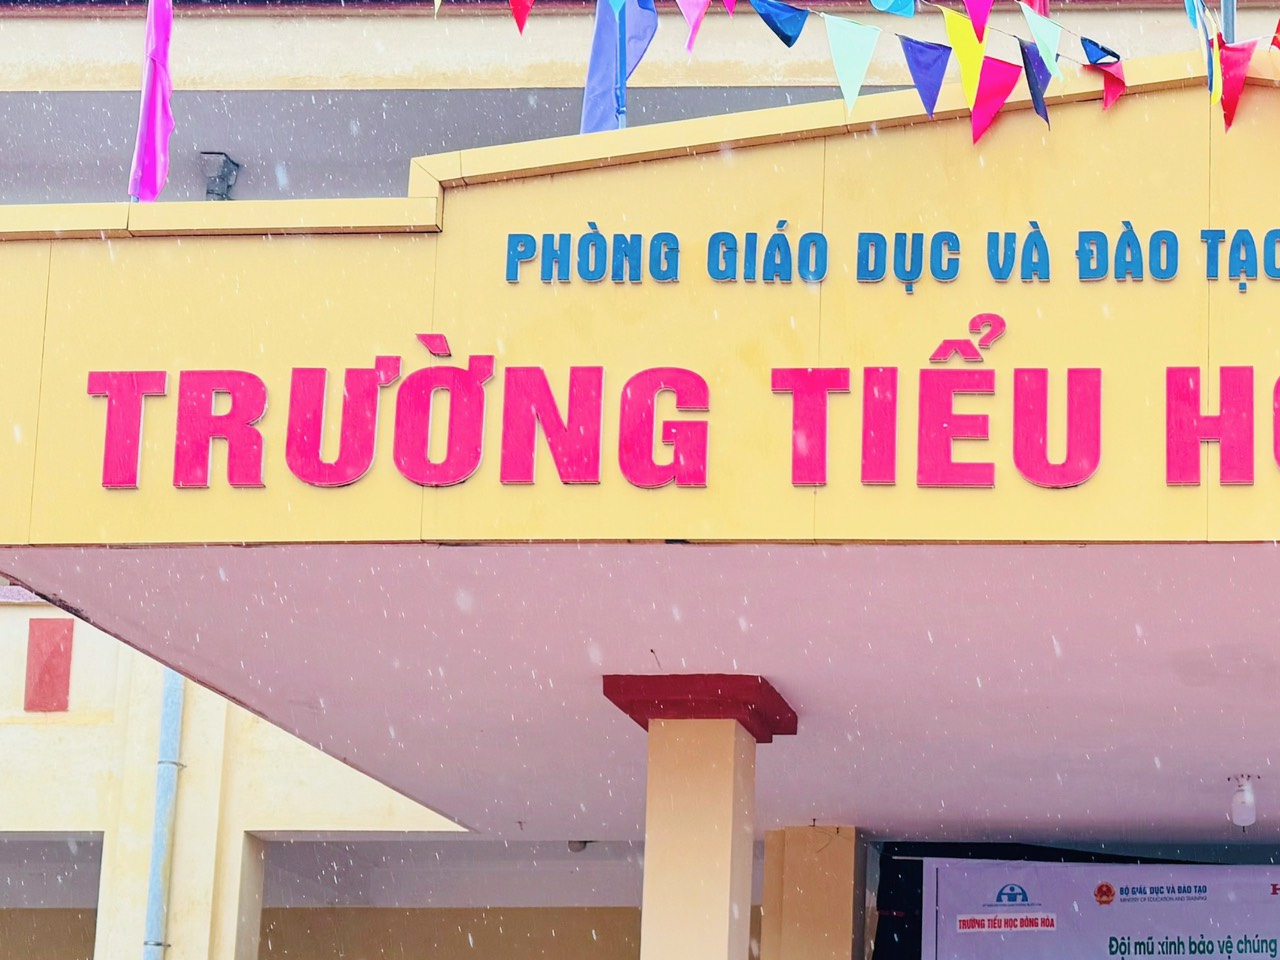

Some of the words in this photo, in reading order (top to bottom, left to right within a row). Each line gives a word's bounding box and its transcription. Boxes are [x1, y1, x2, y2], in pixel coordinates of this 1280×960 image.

[506, 222, 680, 283] PHÒNG
[707, 220, 828, 283] GIÁO
[857, 231, 960, 294] DỤC
[987, 221, 1050, 282] VÀ
[1076, 221, 1179, 282] ĐÀO
[87, 334, 710, 489] TRƯỜNG
[771, 312, 1103, 489] TIỂU
[1109, 936, 1130, 960] Đội
[1134, 937, 1155, 955] mũ
[1158, 937, 1185, 955] xinh
[1189, 934, 1214, 955] bảo
[1217, 935, 1234, 959] vệ
[1237, 934, 1278, 958] chúng
